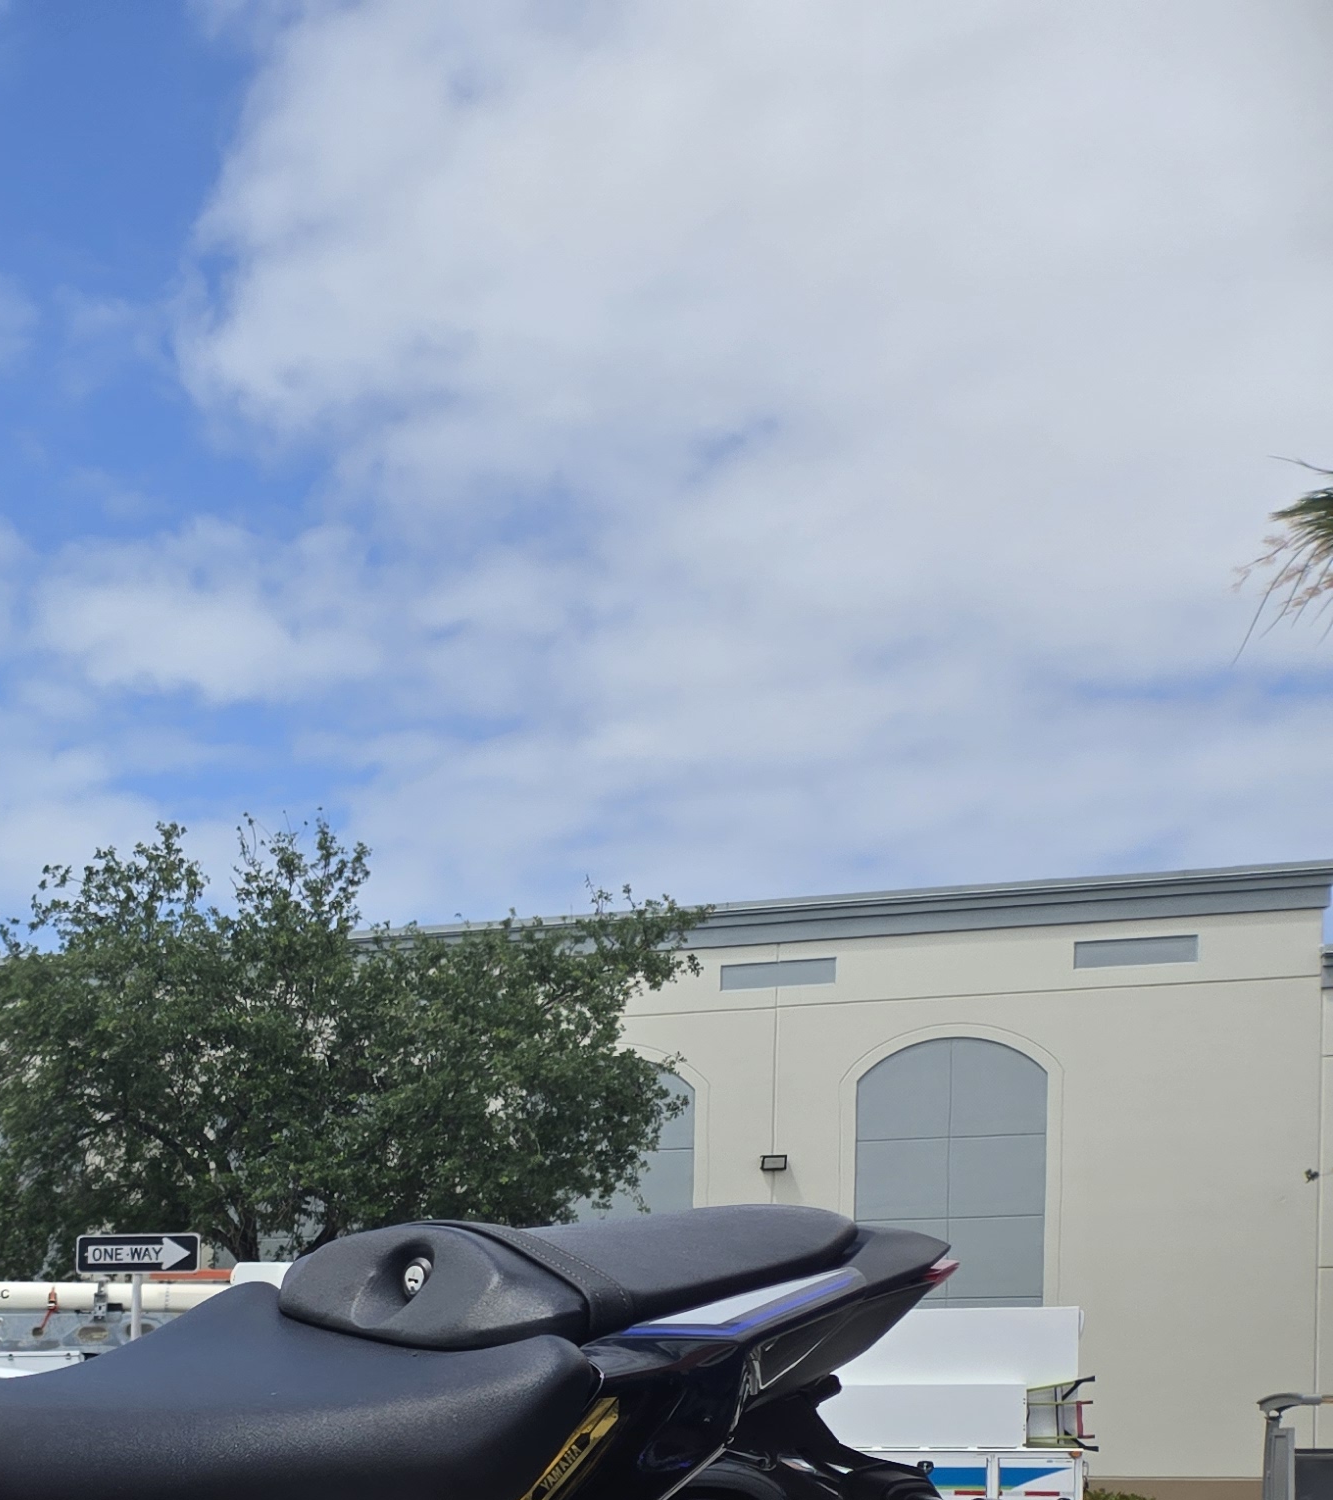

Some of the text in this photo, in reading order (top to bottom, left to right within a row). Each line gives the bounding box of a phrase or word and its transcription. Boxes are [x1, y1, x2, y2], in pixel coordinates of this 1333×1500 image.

[92, 1246, 163, 1262] ONE WAY
[540, 1444, 582, 1491] YAMAHA
